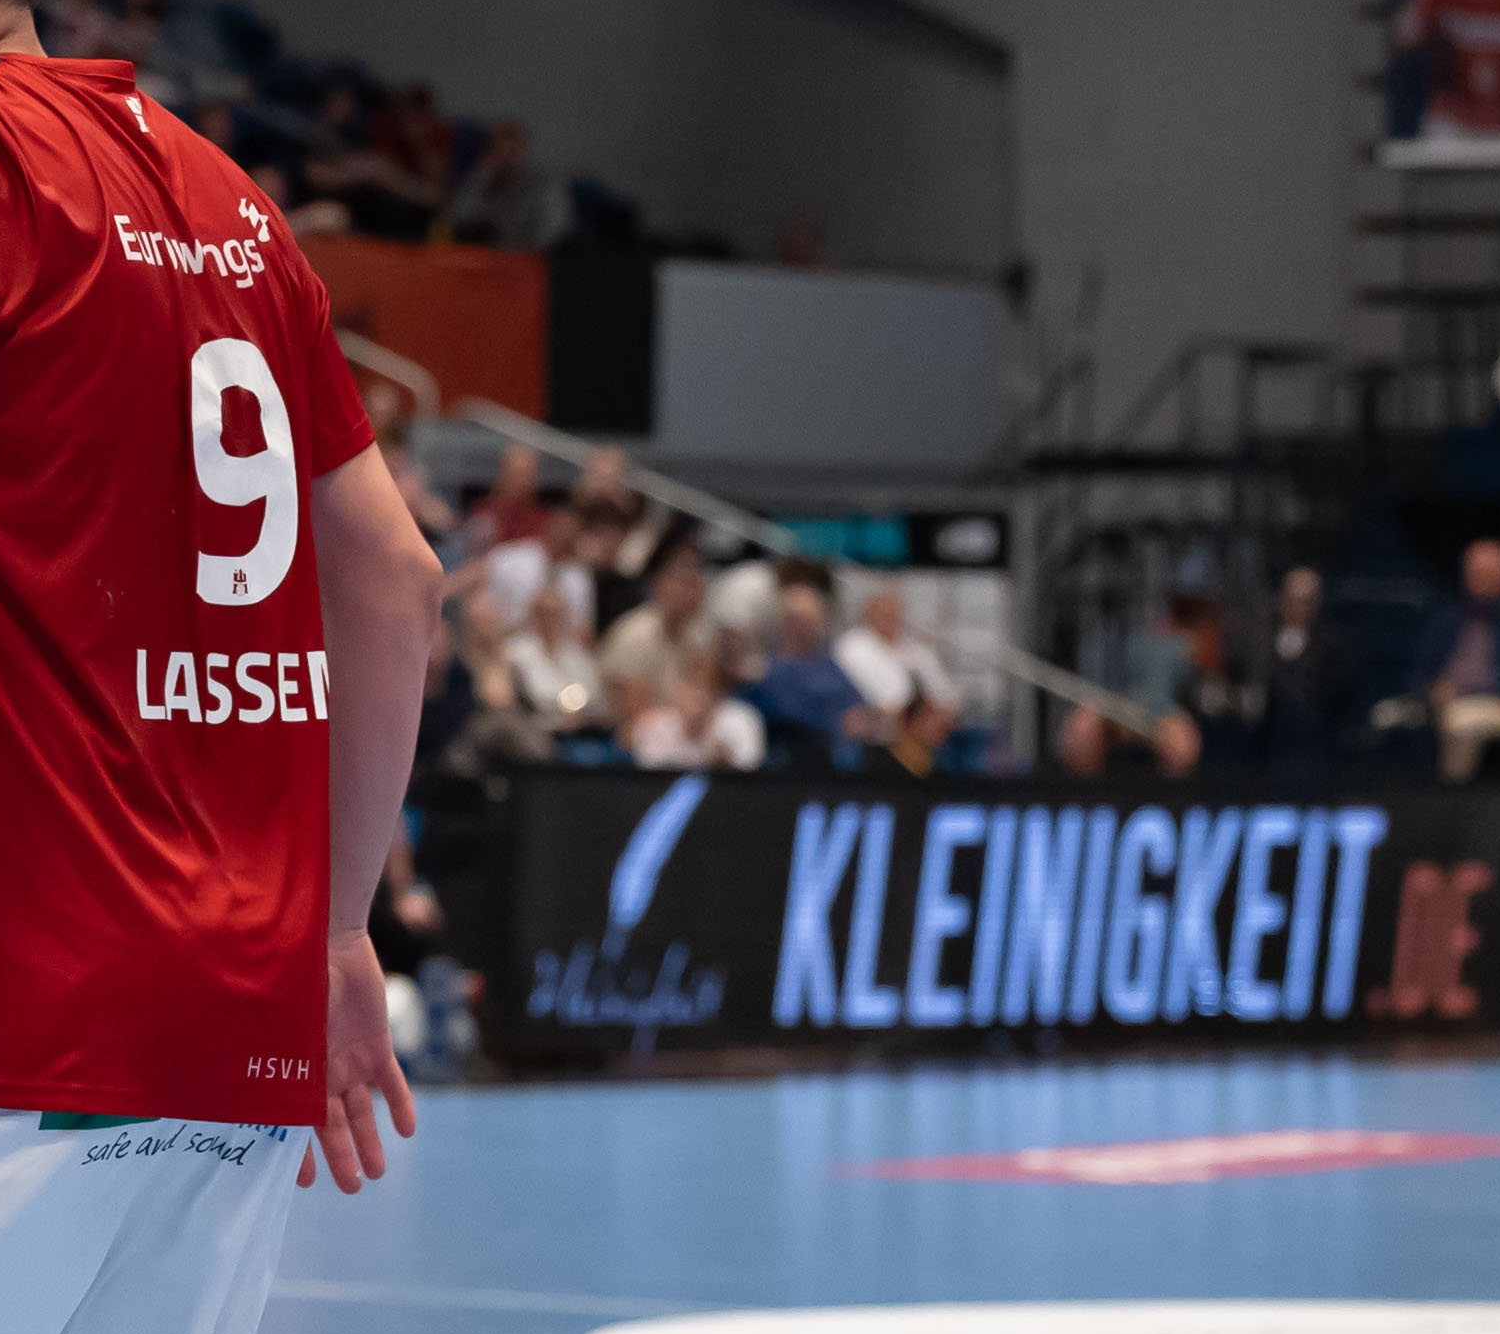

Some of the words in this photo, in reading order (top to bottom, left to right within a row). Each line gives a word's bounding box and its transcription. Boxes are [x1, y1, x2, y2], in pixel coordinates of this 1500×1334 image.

[114, 215, 265, 289] Eurwngs
[191, 337, 299, 606] 9
[247, 1056, 310, 1080] HSVH
[82, 1132, 131, 1165] safe
